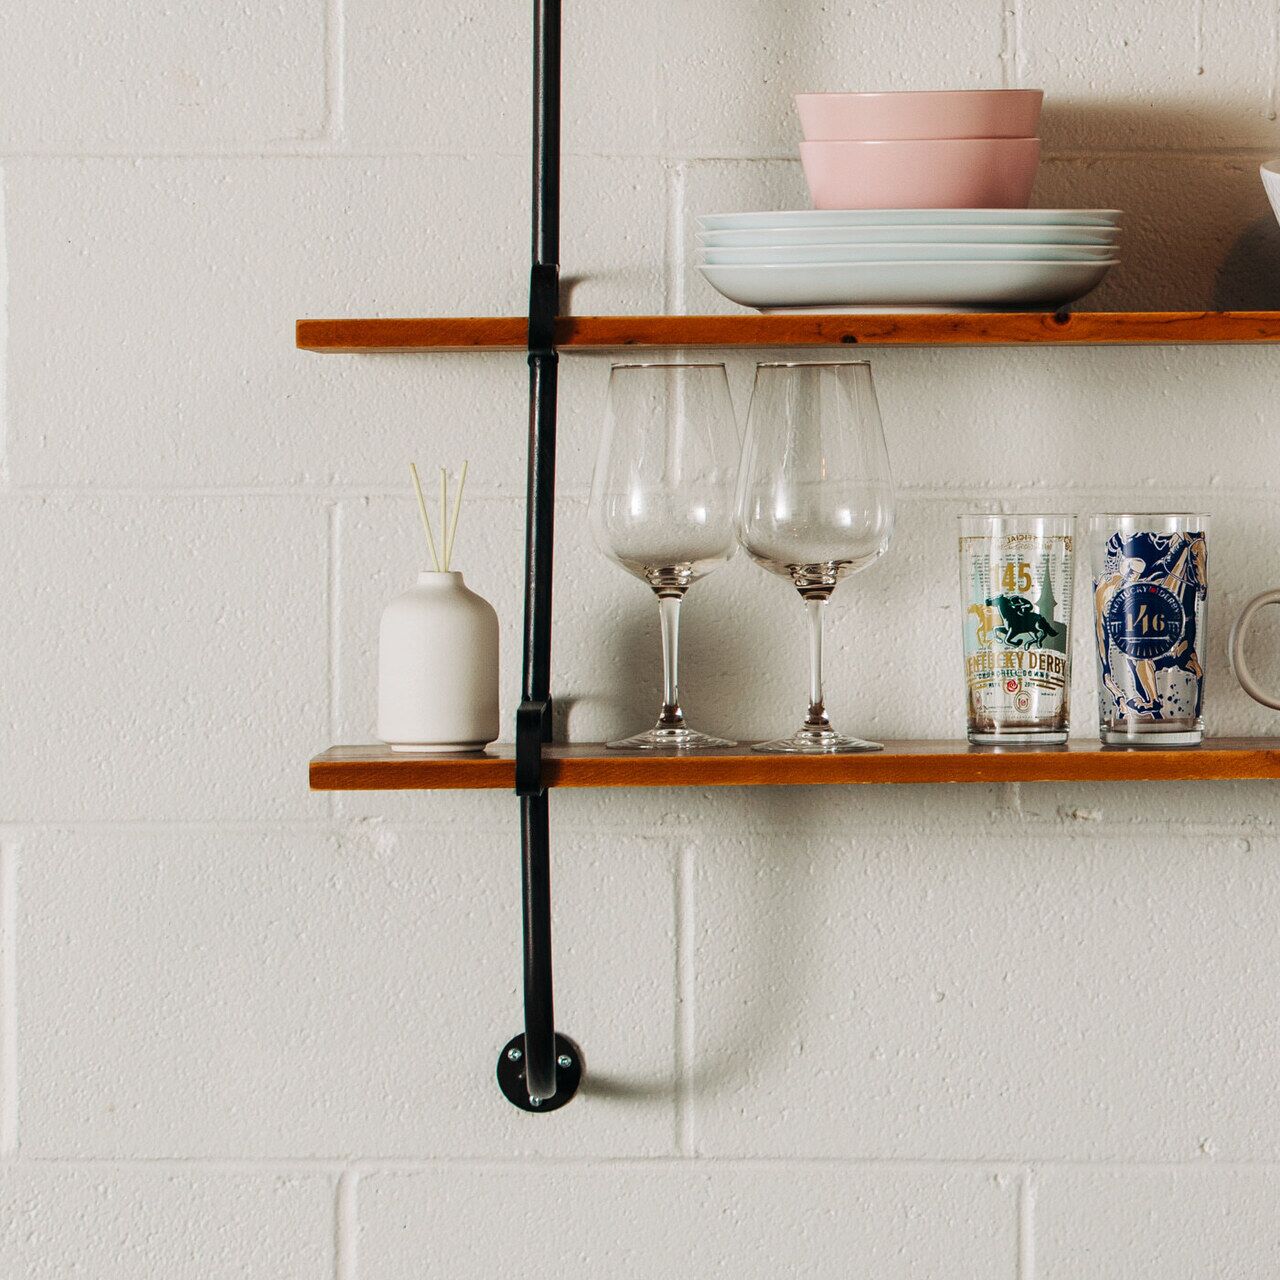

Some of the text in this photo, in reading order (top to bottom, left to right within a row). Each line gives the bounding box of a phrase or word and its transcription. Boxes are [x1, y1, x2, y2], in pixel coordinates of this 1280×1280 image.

[1111, 586, 1180, 614] KENTUCKY DERBY
[1125, 604, 1166, 635] 146
[1028, 651, 1067, 676] DERBY
